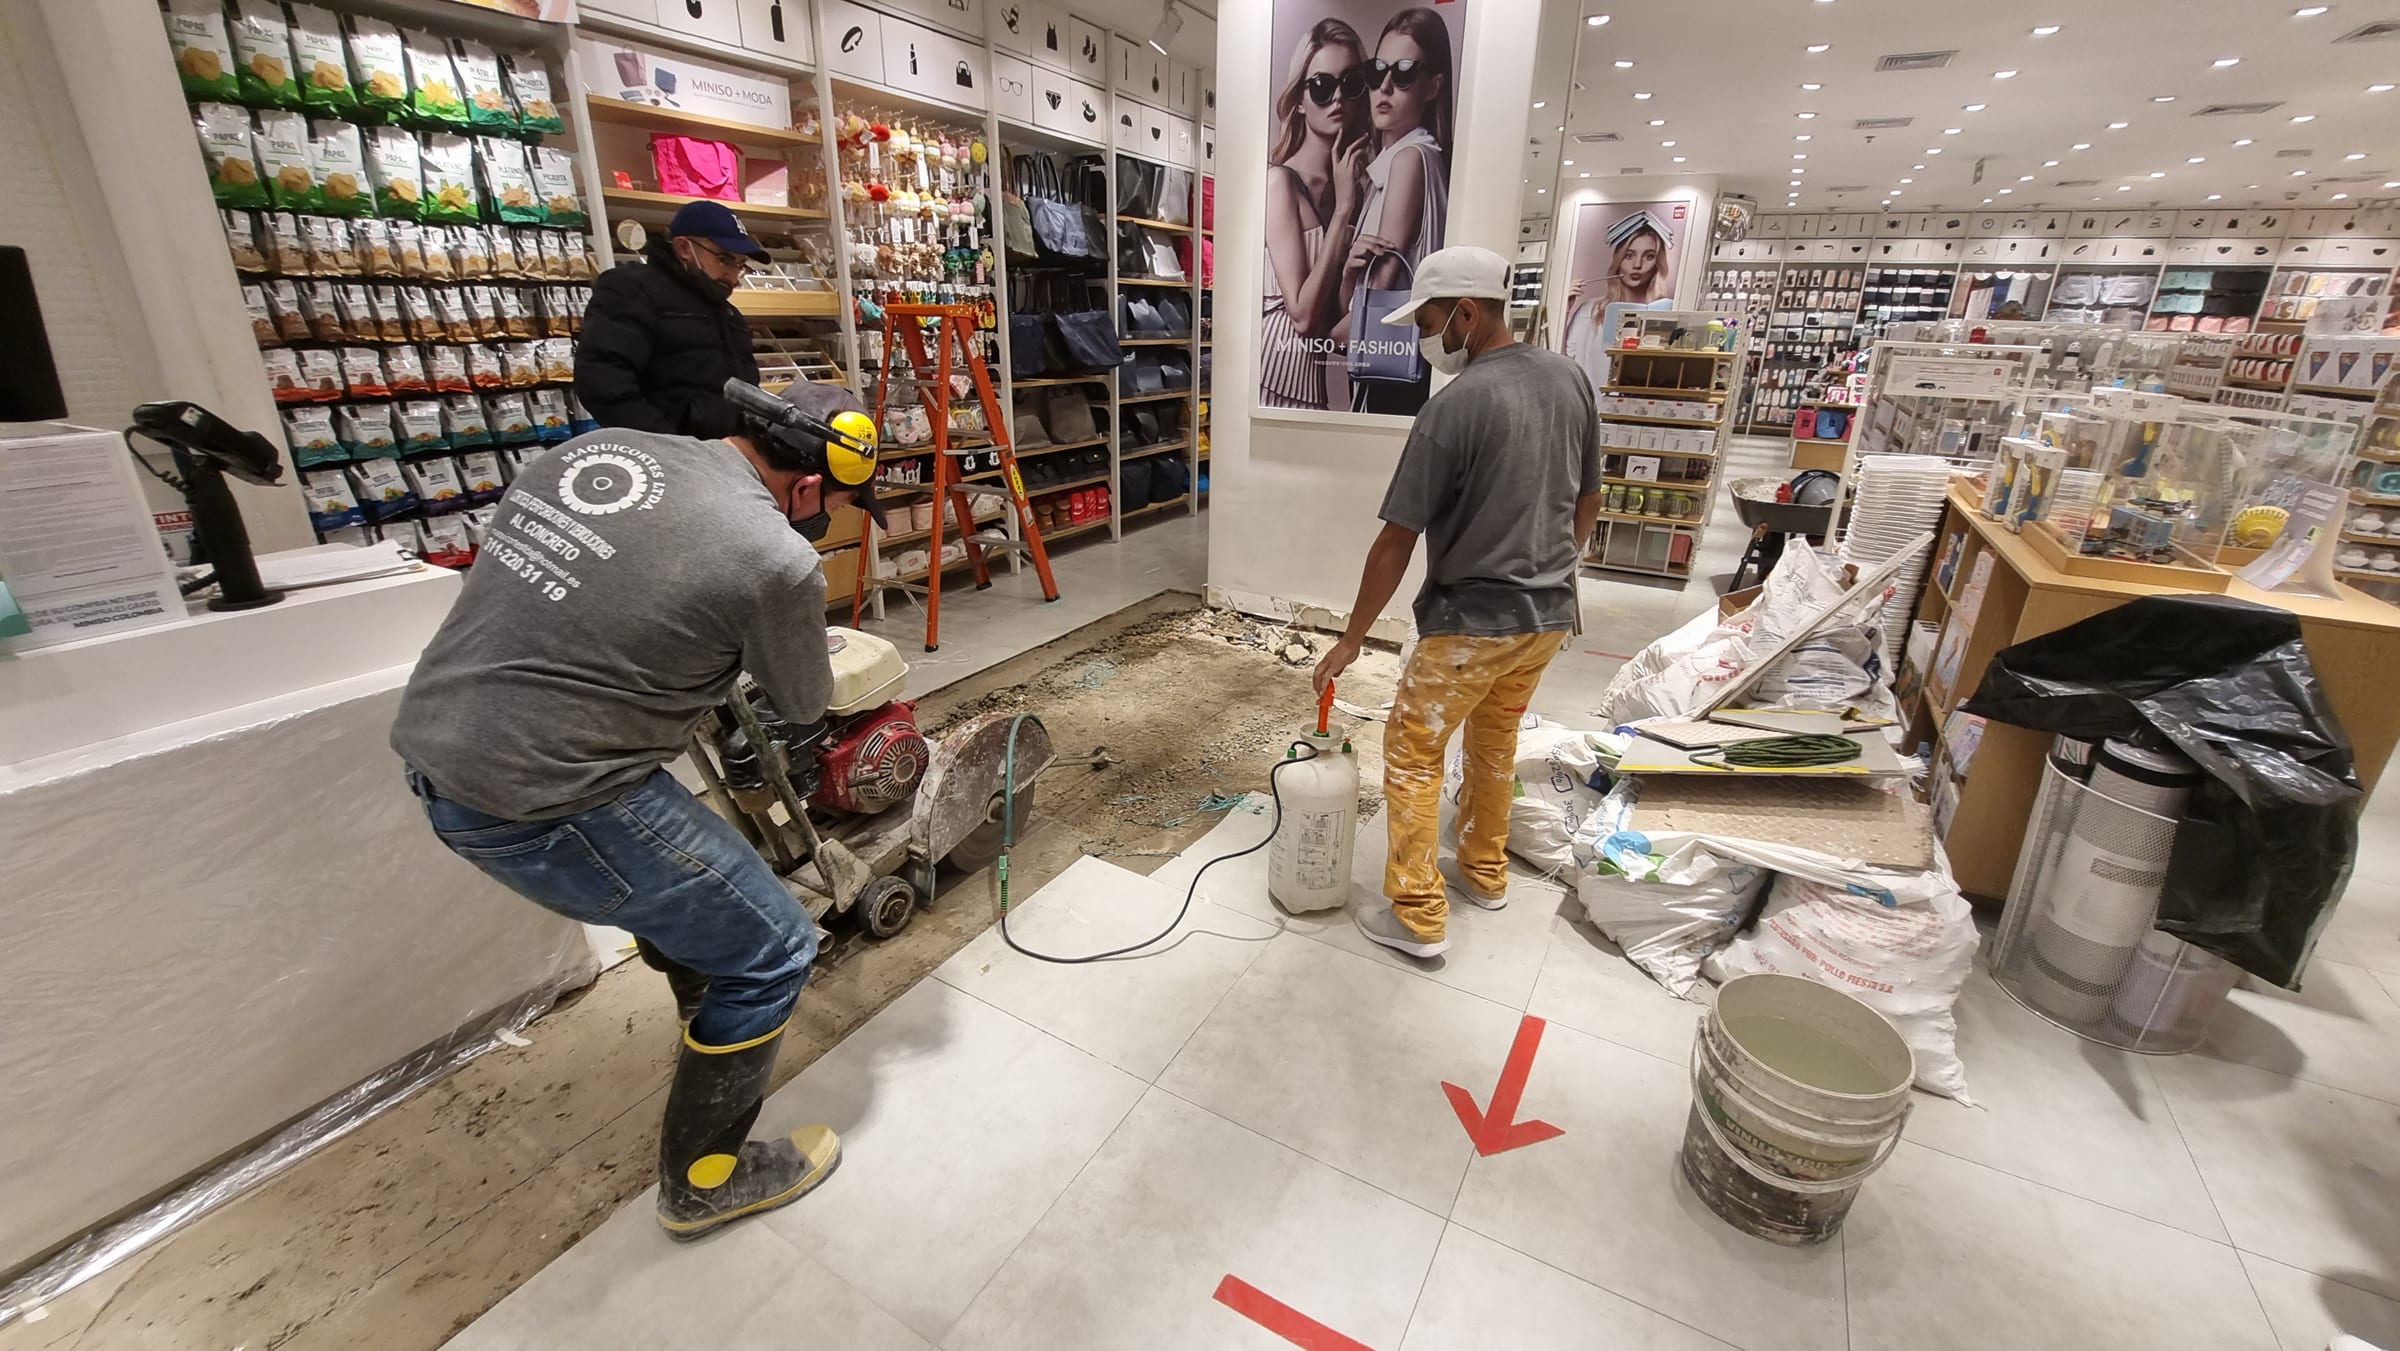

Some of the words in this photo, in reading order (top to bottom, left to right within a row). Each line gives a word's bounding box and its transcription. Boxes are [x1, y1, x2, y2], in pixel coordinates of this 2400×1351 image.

[691, 78, 733, 98] MINISO
[742, 90, 774, 106] MODA
[1275, 338, 1335, 354] MINISO
[1350, 340, 1416, 356] FASHION
[560, 443, 665, 479] MAQUICORTES
[509, 513, 526, 530] AL
[523, 520, 581, 561] CONCRETO
[519, 564, 544, 584] 31
[542, 580, 567, 601] 19
[1819, 959, 1846, 979] POLLO
